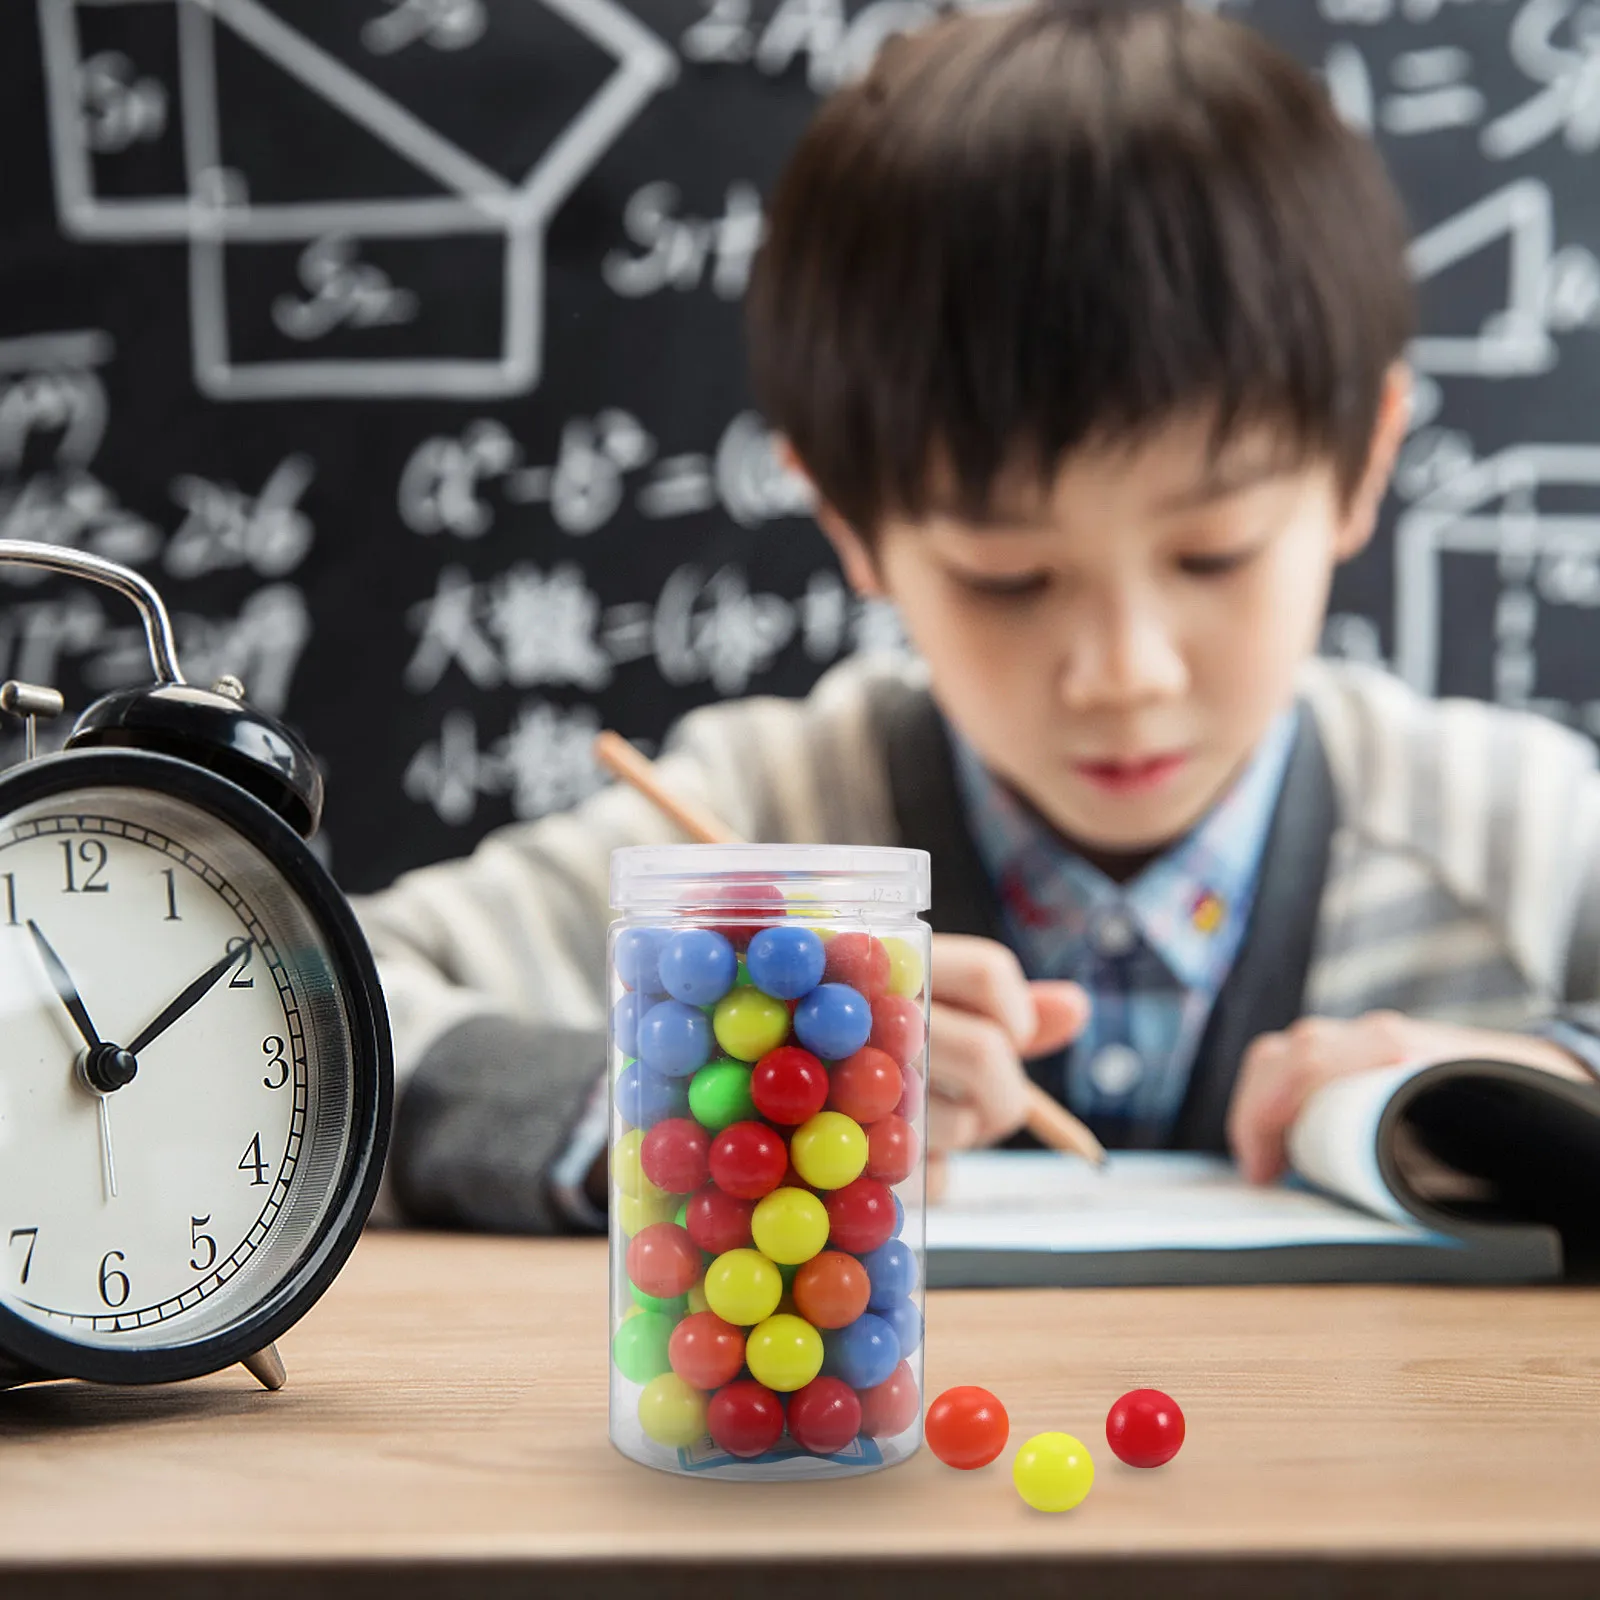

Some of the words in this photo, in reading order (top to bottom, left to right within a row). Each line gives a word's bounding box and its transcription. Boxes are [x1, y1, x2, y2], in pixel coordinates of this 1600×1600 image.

[58, 838, 110, 894] 12
[0, 871, 22, 926] 1
[161, 867, 183, 922] 1
[225, 935, 255, 989] 2
[262, 1034, 291, 1090] 3
[238, 1131, 270, 1187] 4
[9, 1226, 39, 1286] 7
[189, 1213, 219, 1274] 5
[98, 1250, 131, 1308] 6
